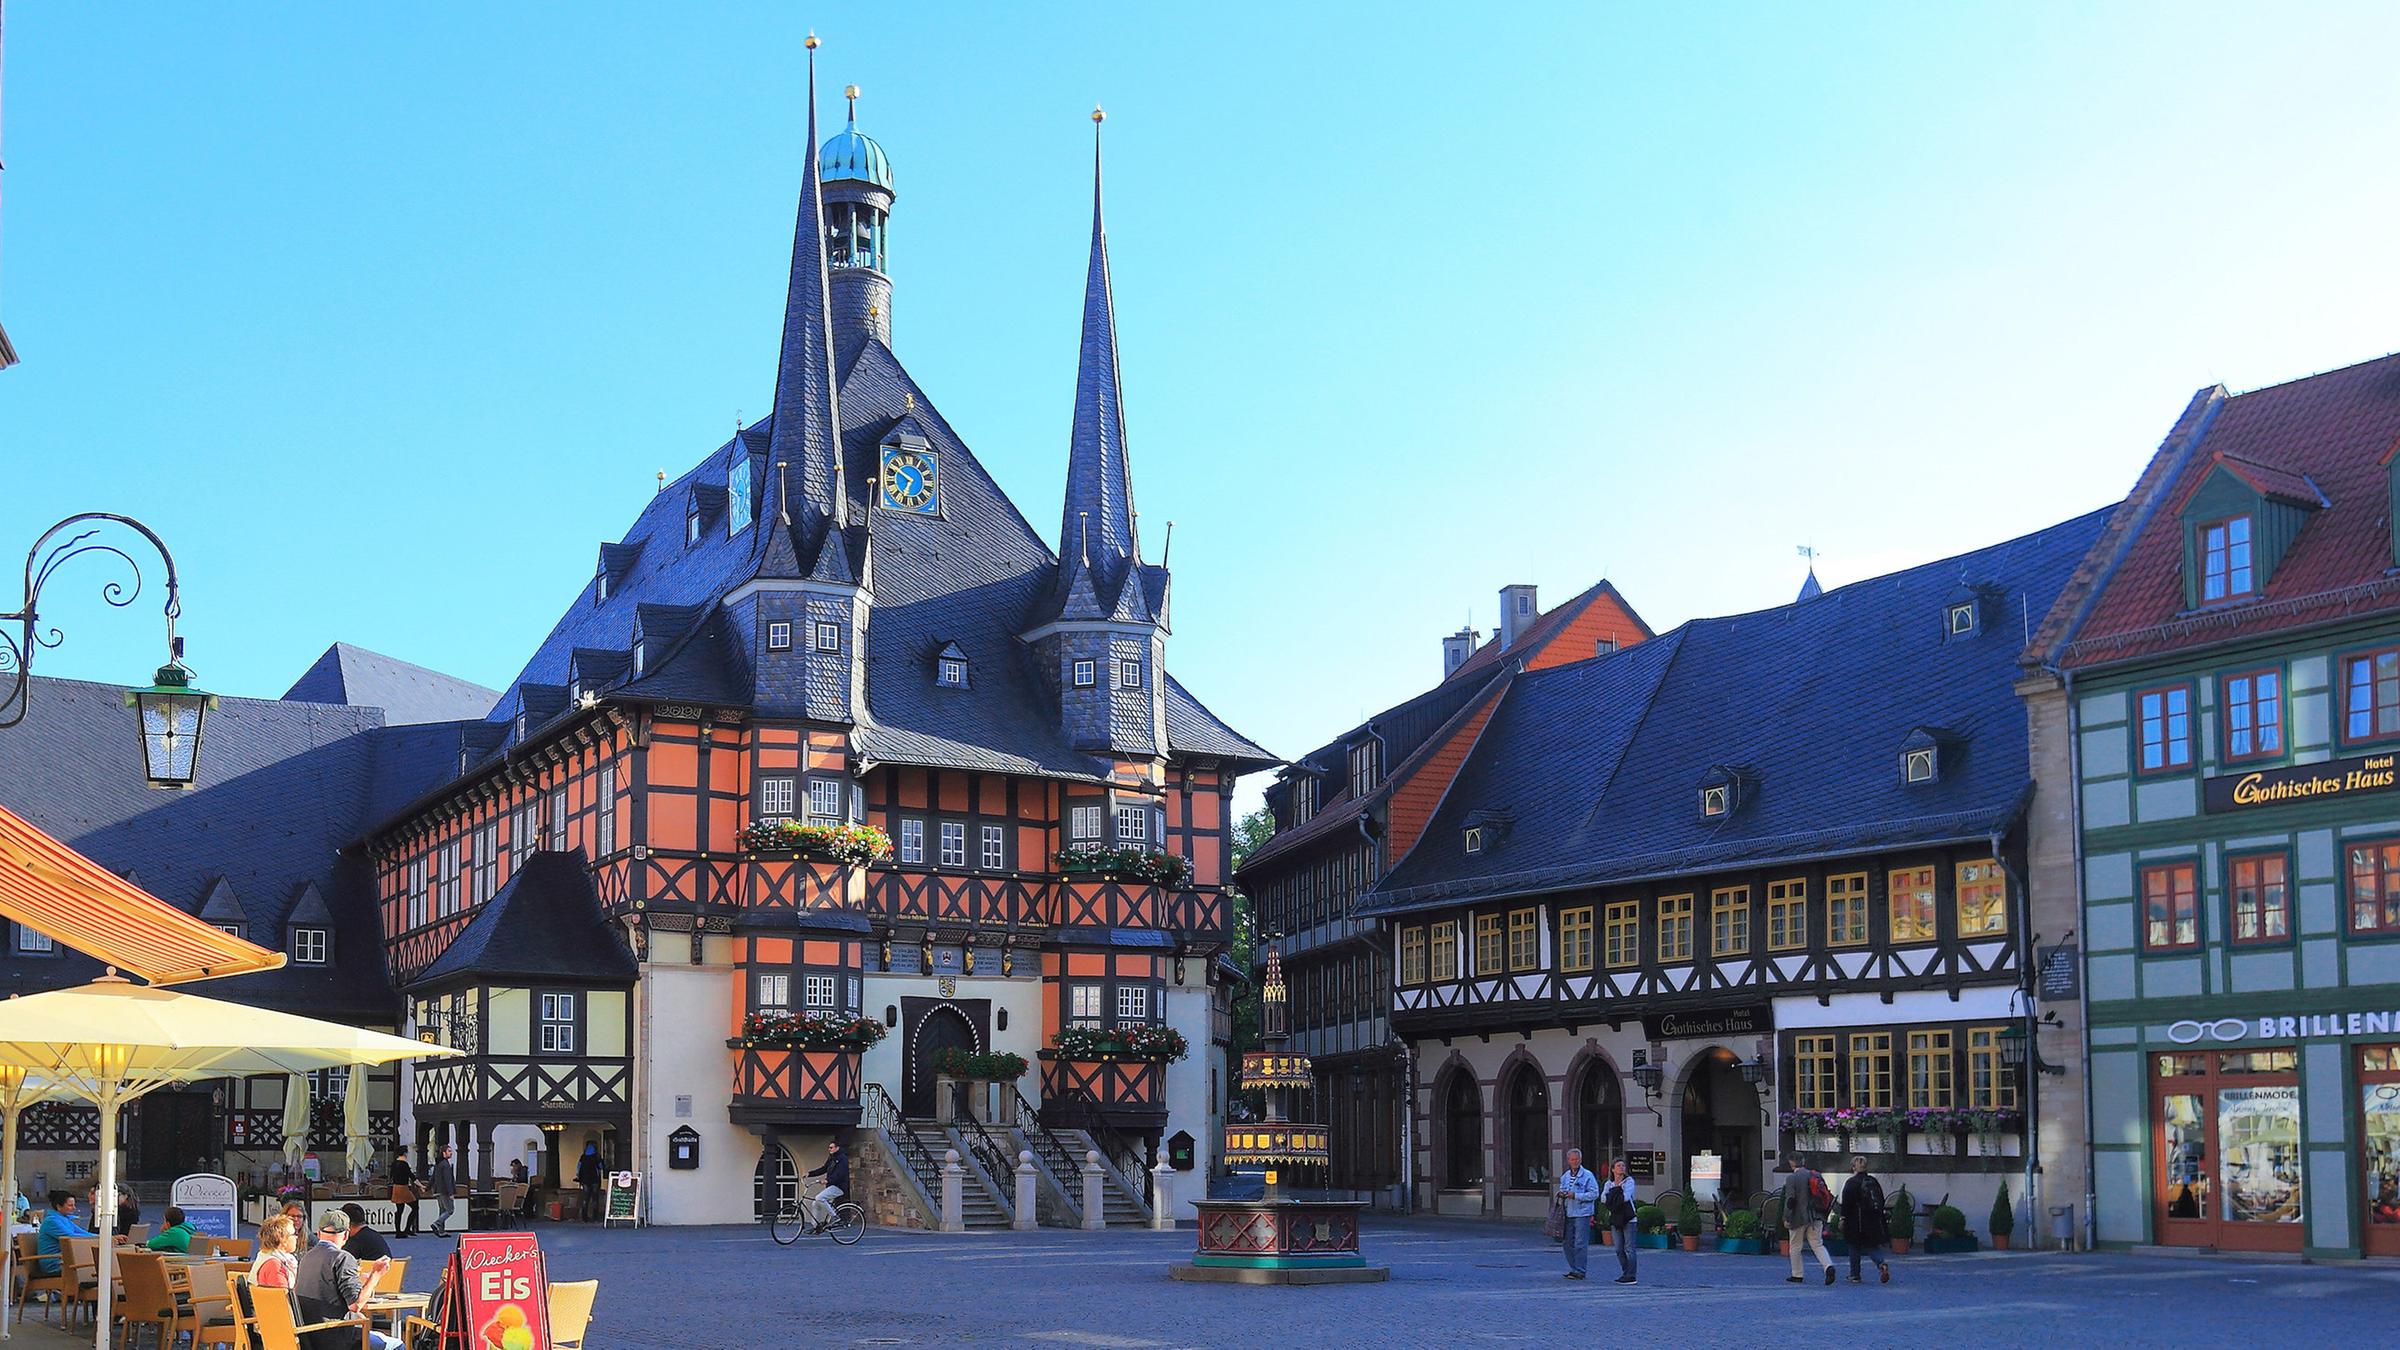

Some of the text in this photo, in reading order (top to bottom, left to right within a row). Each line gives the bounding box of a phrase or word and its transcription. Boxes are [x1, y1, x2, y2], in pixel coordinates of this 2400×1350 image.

[2364, 756, 2394, 770] Hotel
[2233, 769, 2394, 804] Gothisches Haus
[1732, 1008, 1751, 1018] Hotel
[1661, 1014, 1753, 1036] Gothisches Haus
[2258, 1011, 2400, 1039] BRILLEN
[2224, 1090, 2297, 1101] BRILLENMODE
[481, 1269, 531, 1301] Eis
